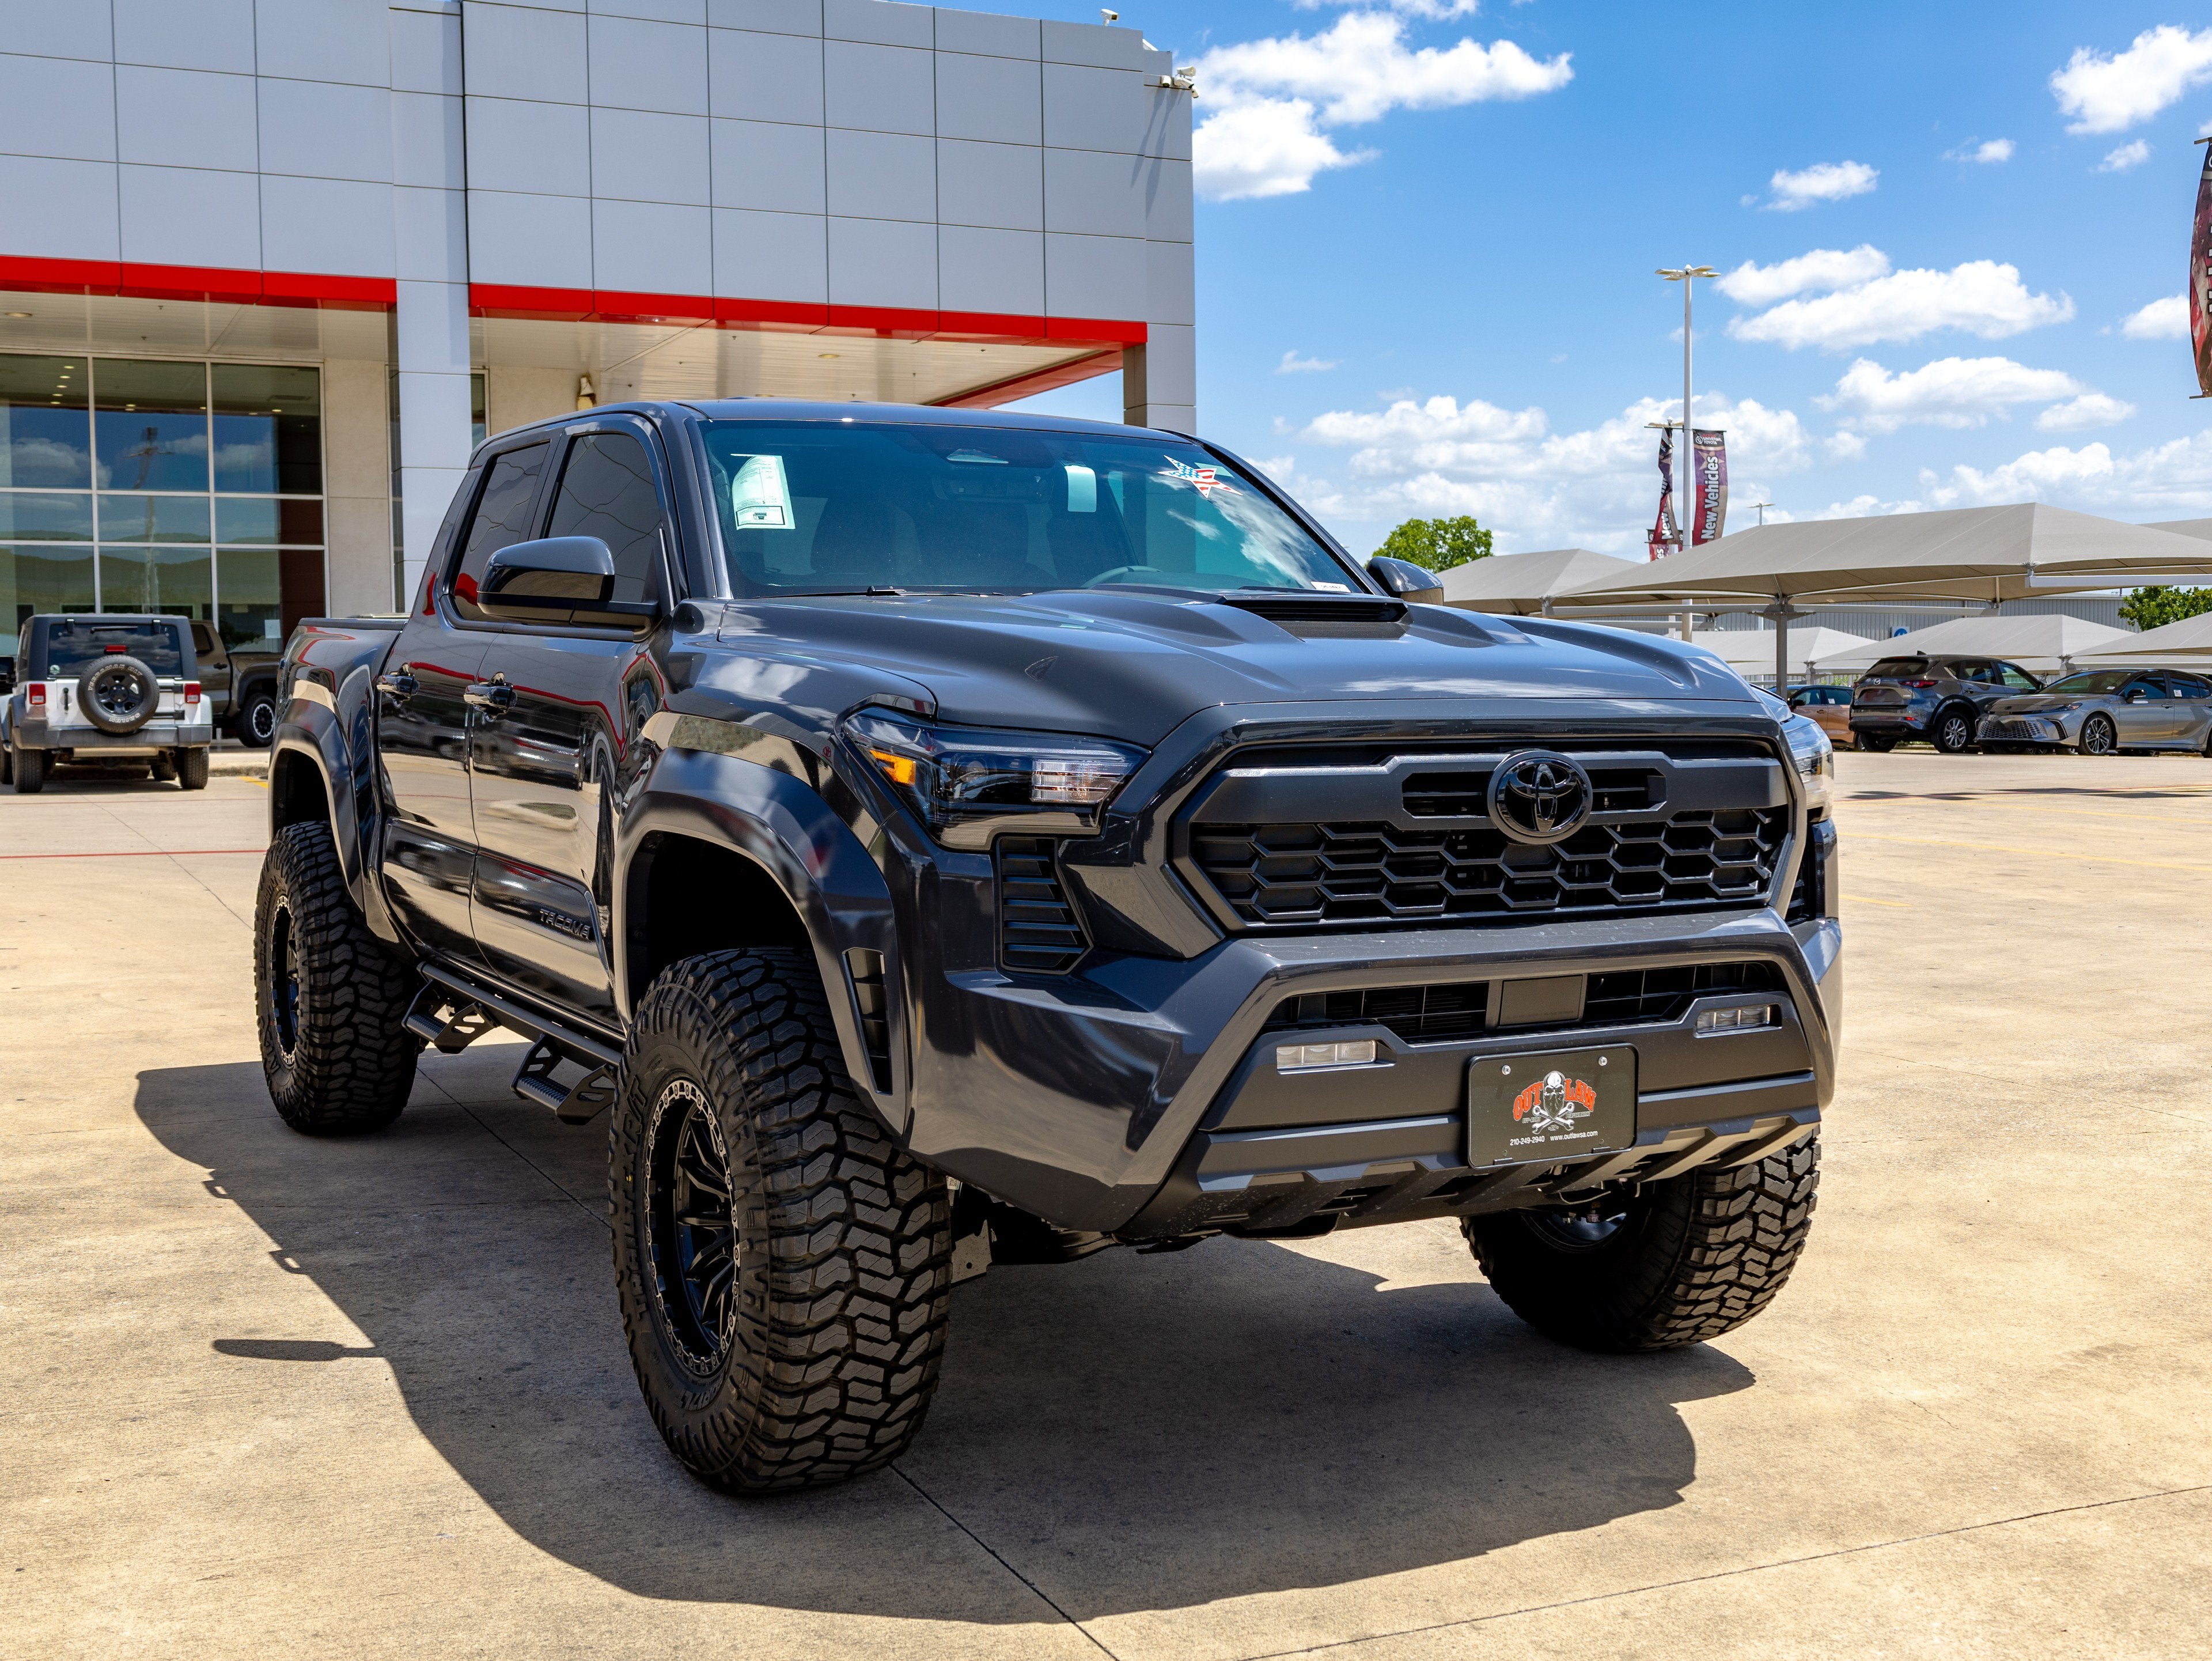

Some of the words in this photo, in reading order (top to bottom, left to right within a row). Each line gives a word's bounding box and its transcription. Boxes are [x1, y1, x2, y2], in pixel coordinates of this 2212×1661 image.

[1705, 456, 1719, 509] Vehicles
[1661, 512, 1674, 540] New
[1701, 512, 1718, 539] New
[540, 908, 591, 940] TACOMA
[1510, 1136, 1546, 1146] 210-249-2940
[1550, 1130, 1599, 1141] www.outlawsa.com
